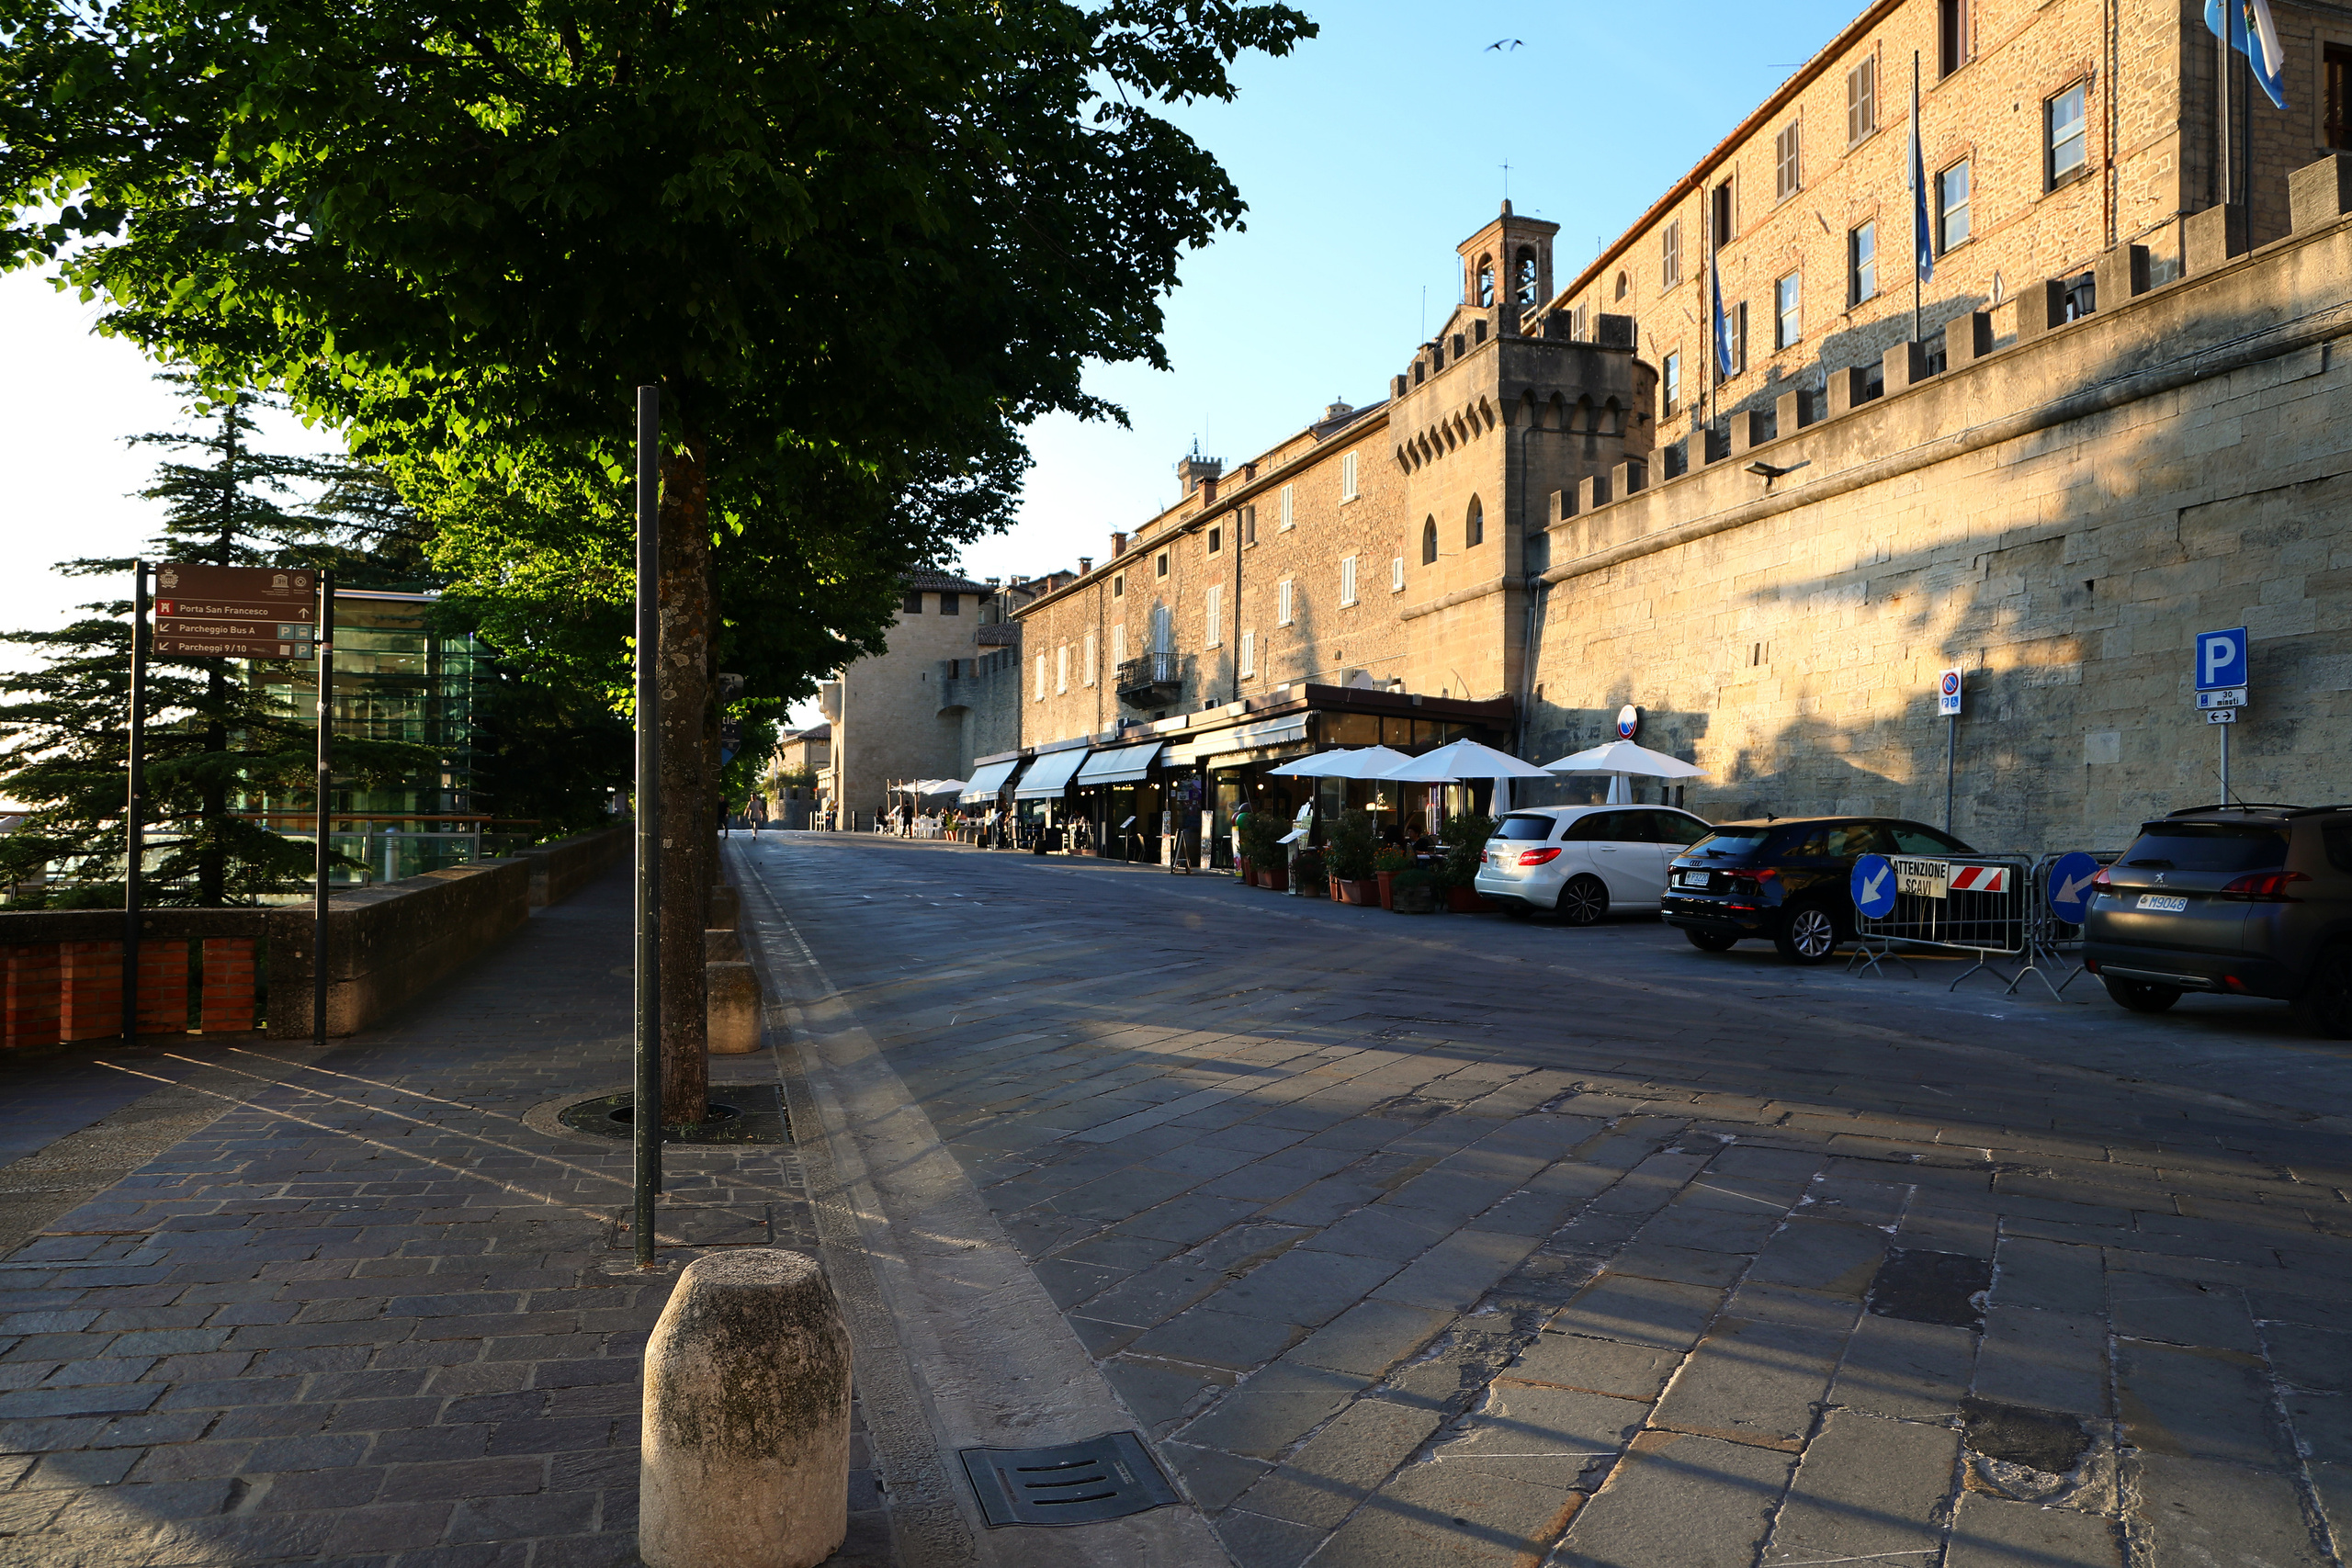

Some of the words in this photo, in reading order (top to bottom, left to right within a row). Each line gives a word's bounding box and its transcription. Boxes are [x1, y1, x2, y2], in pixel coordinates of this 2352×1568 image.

[179, 604, 204, 614] Porta
[206, 605, 222, 614] San
[224, 606, 268, 615] Francesco
[179, 624, 229, 635] Parcheggio
[230, 626, 247, 634] Bus
[248, 626, 255, 635] A
[178, 642, 222, 654] Parcheggi
[2205, 636, 2236, 684] P
[2216, 697, 2239, 706] minuti
[1894, 860, 1947, 878] ATTENZIONE
[1905, 878, 1931, 896] SCAVI
[2149, 896, 2187, 910] M9048
